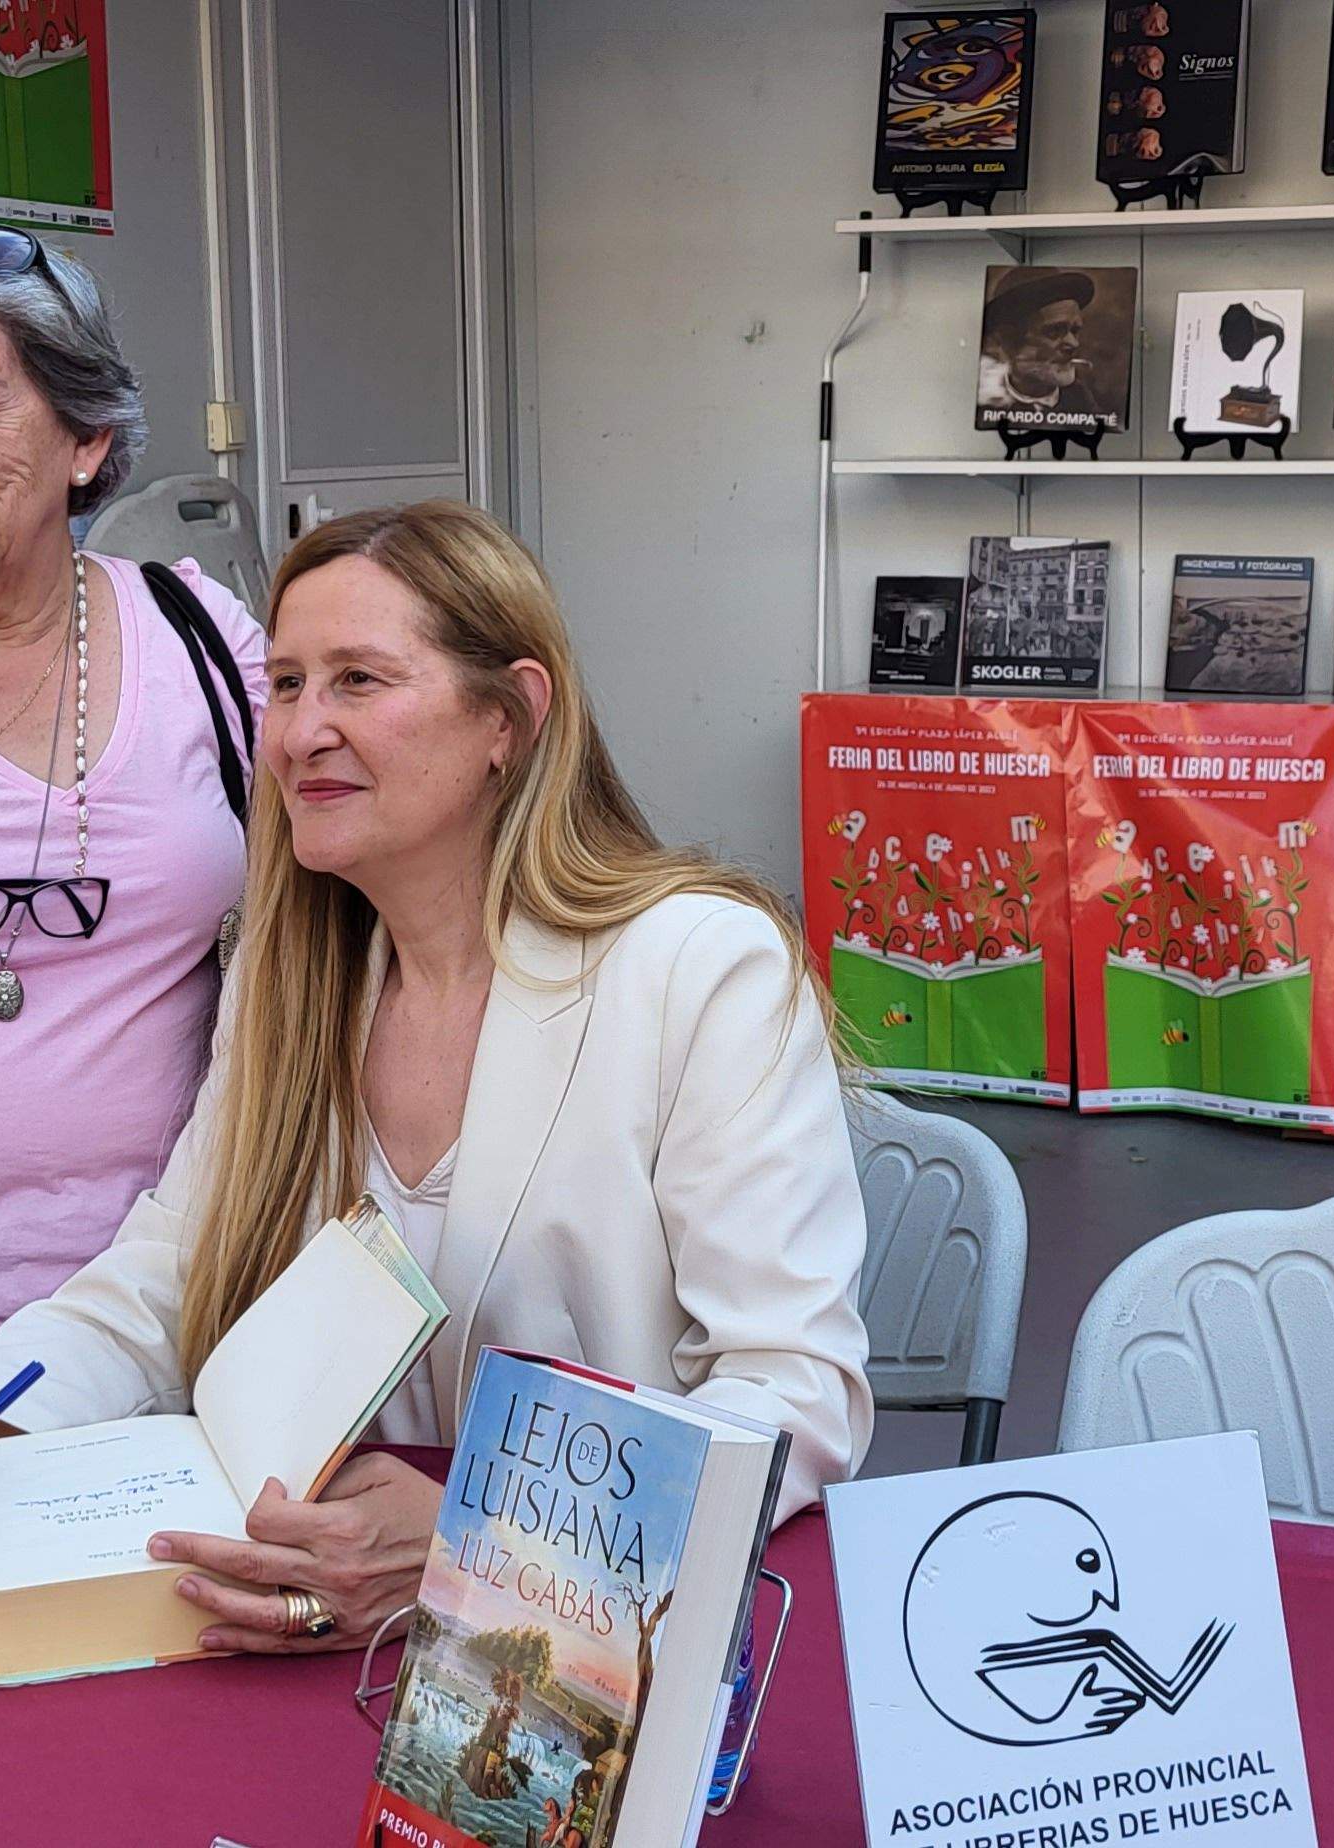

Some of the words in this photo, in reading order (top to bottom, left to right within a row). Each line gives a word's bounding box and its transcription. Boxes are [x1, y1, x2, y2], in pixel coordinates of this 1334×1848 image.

[1179, 54, 1236, 75] Signos
[984, 410, 1044, 424] RICARDO
[971, 664, 1042, 680] SKOGLER
[856, 727, 866, 735] 39
[828, 746, 871, 770] FERIA
[877, 749, 904, 771] DEL
[909, 750, 954, 773] LIBRO
[960, 752, 979, 774] DE
[985, 753, 1050, 777] HUESCA
[1093, 755, 1132, 778] FERIA
[1138, 755, 1167, 779] DEL
[1172, 757, 1223, 780] LIBRO
[1228, 759, 1250, 780] DE
[1255, 759, 1325, 782] HUESCA
[842, 810, 866, 842] a
[1011, 815, 1037, 842] m
[885, 835, 901, 862] c
[926, 833, 944, 863] e
[499, 1393, 644, 1501] LEJOS
[577, 1445, 601, 1467] DE
[459, 1453, 647, 1584] LUISIANA
[457, 1533, 513, 1587] LUZ
[516, 1562, 617, 1636] GABÁS
[890, 1778, 1084, 1836] ASOCIACIÓN
[1093, 1750, 1276, 1800] PROVINCIAL
[1119, 1807, 1160, 1837] DE
[1169, 1787, 1293, 1832] HUESCA
[379, 1808, 428, 1848] PREMIO
